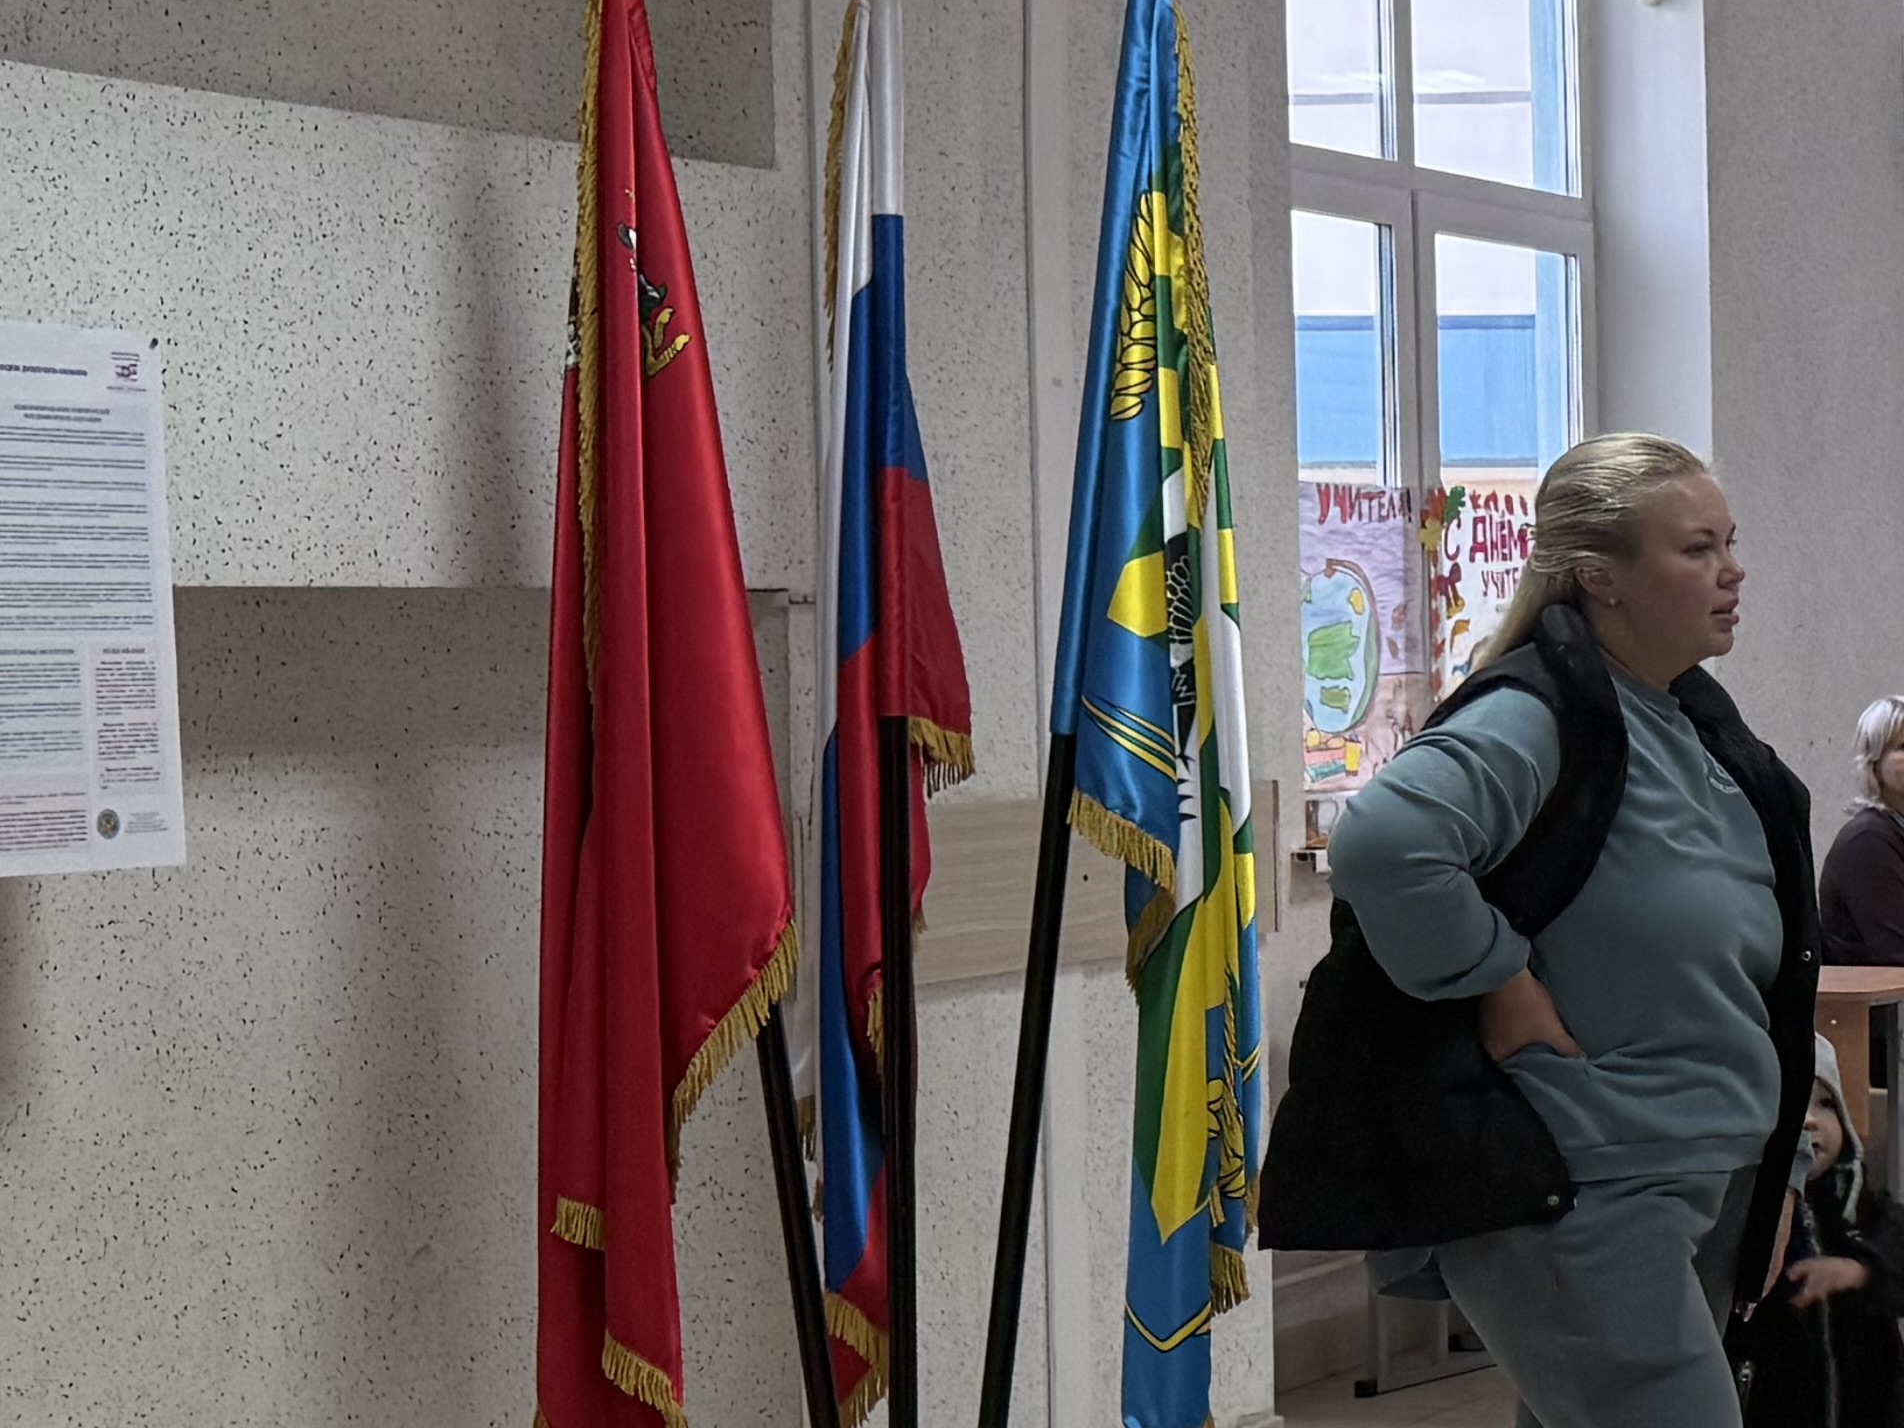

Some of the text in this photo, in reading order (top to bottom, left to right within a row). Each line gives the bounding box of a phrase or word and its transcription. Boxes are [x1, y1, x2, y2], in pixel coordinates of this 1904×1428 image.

[1317, 483, 1412, 524] УЧИТЕЛЯ!
[1445, 517, 1461, 561] С
[1481, 567, 1519, 599] УЧИТЕ
